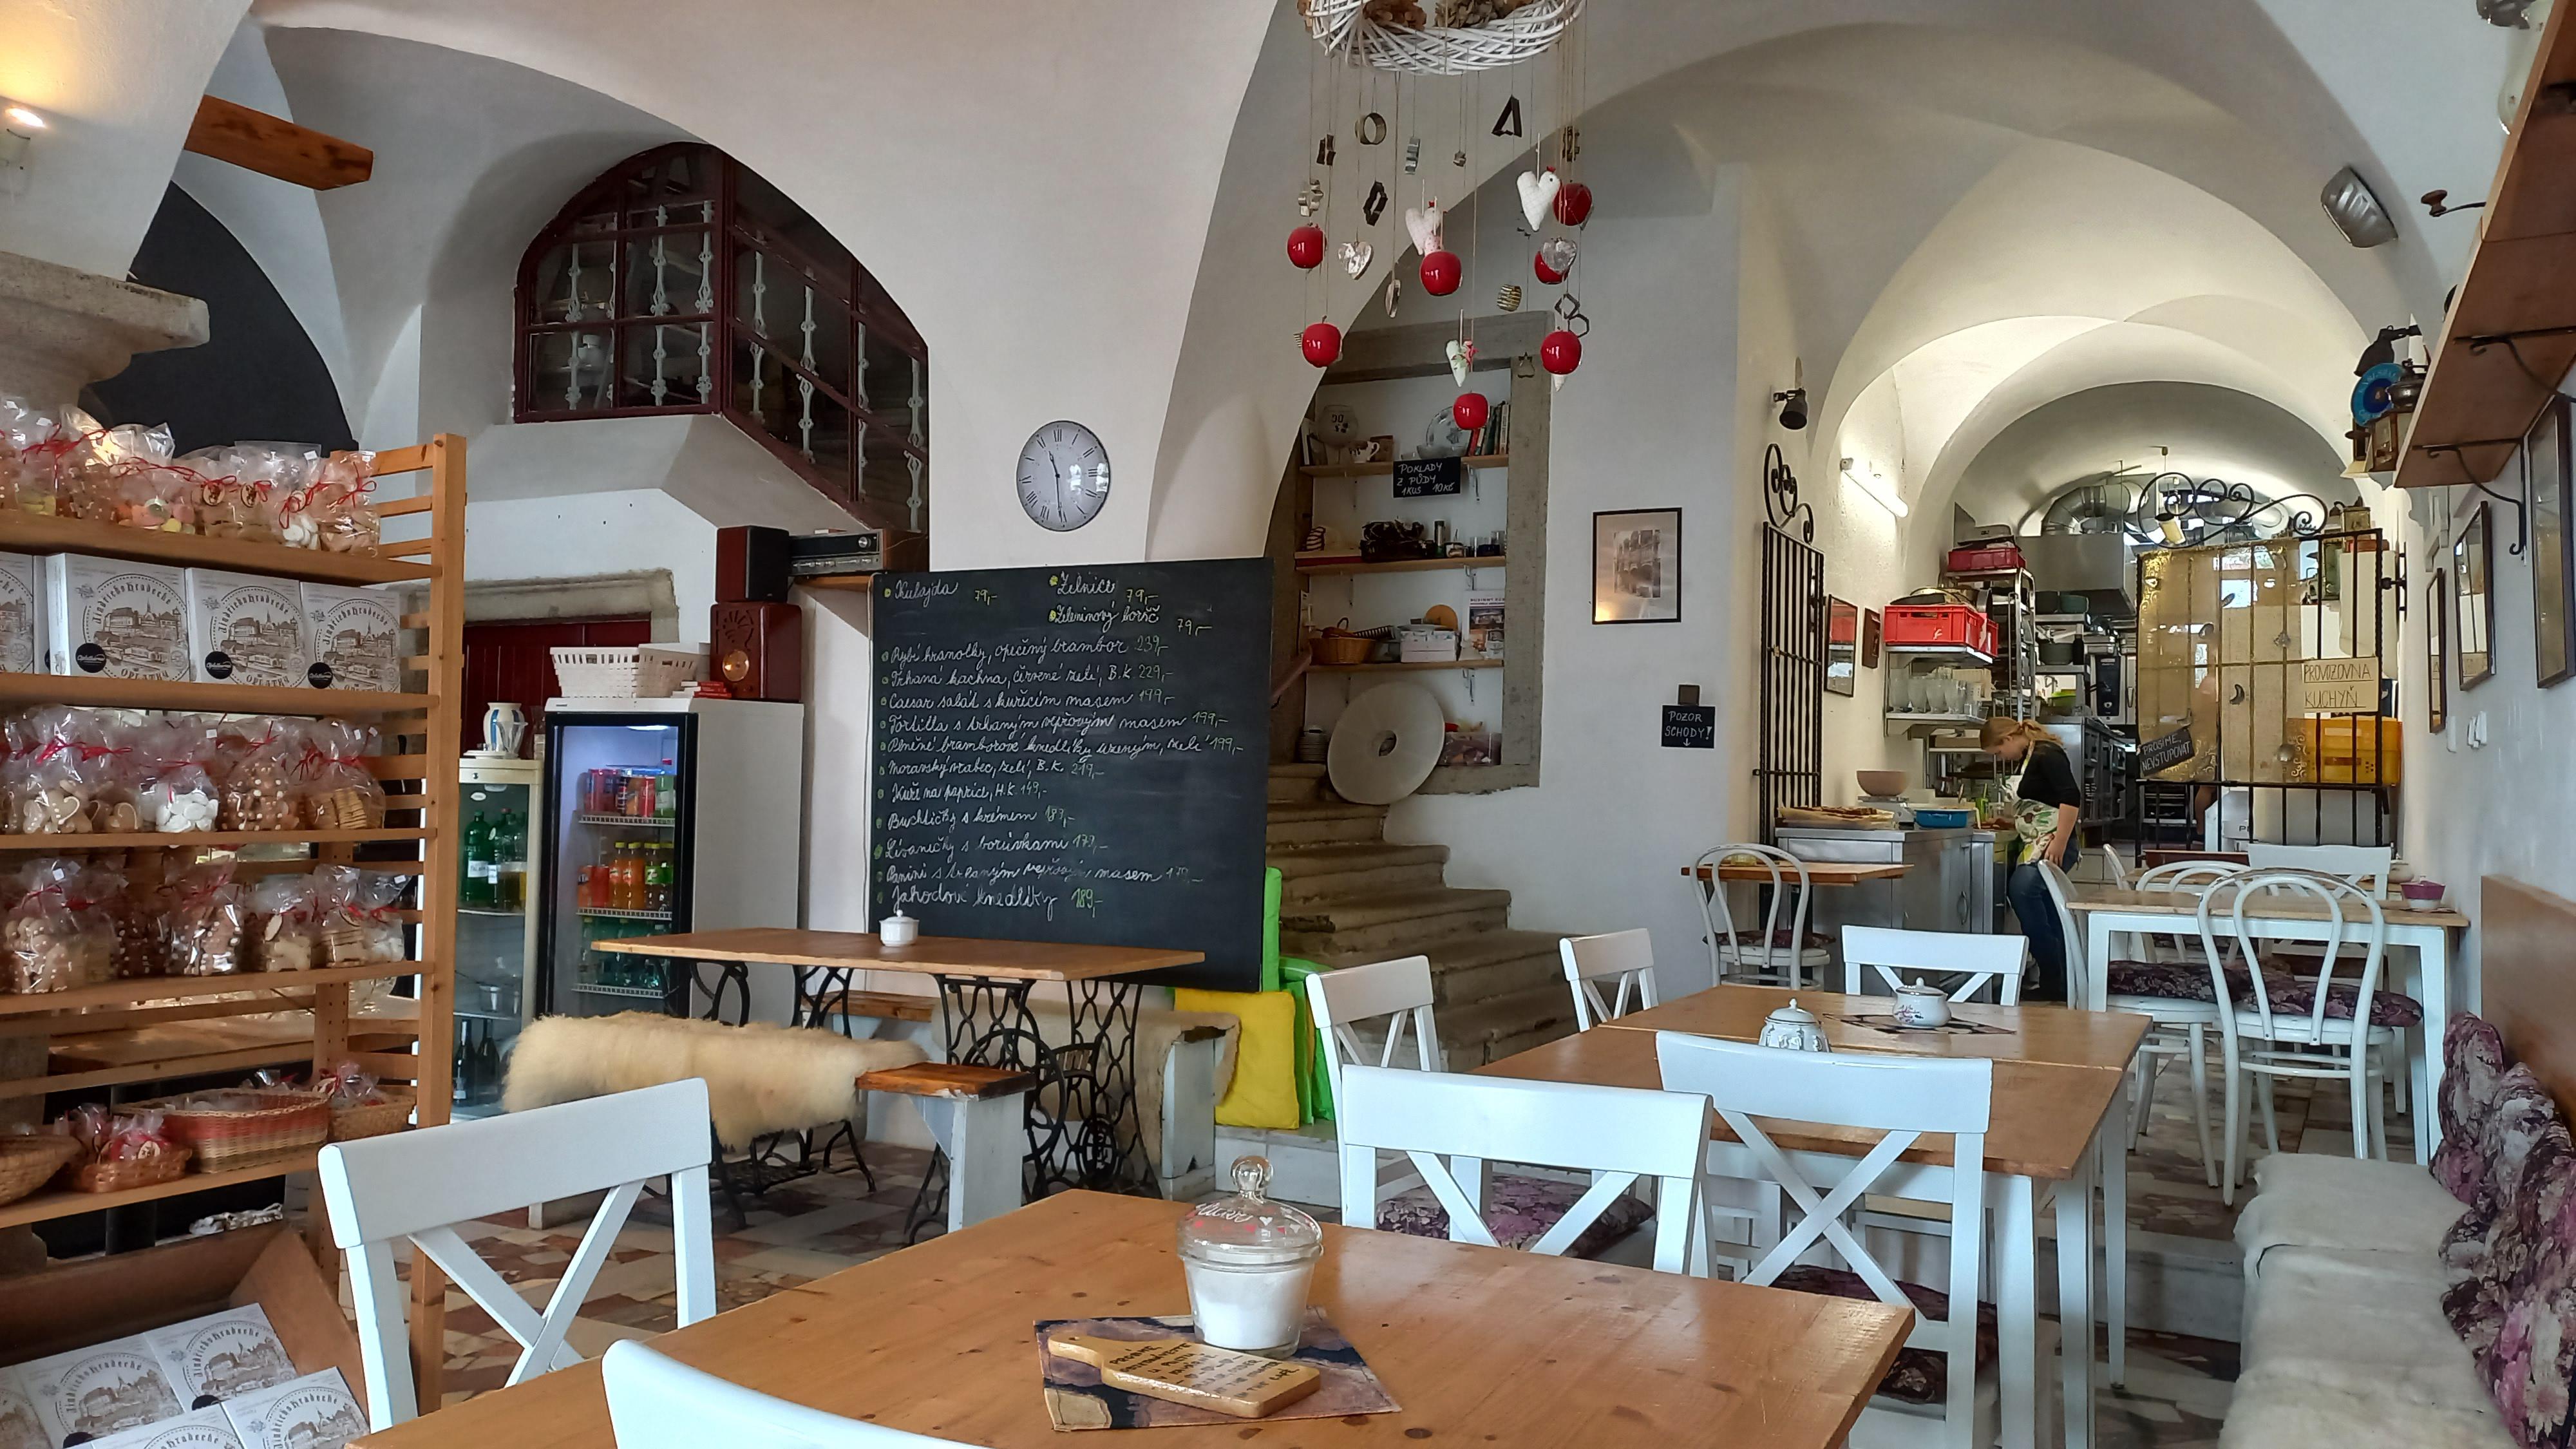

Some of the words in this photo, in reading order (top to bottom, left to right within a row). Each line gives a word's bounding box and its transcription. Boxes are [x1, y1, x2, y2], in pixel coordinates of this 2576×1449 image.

[1397, 462, 1443, 475] POKLADY
[1396, 477, 1404, 486] Z
[1408, 473, 1437, 486] PŮDY
[895, 578, 959, 608] Kulajda
[1050, 635, 1129, 654] brambor
[2304, 663, 2372, 681] PROVOZOVNA
[889, 692, 935, 709] Caesar
[1065, 693, 1134, 708] masem
[2304, 685, 2358, 708] KUCHYŇ
[1118, 717, 1187, 730] masem
[1667, 710, 1703, 723] POZOR
[1664, 724, 1713, 741] SCHODY!
[2141, 741, 2191, 772] NEVSTUPOVAT
[1094, 868, 1163, 882] masem
